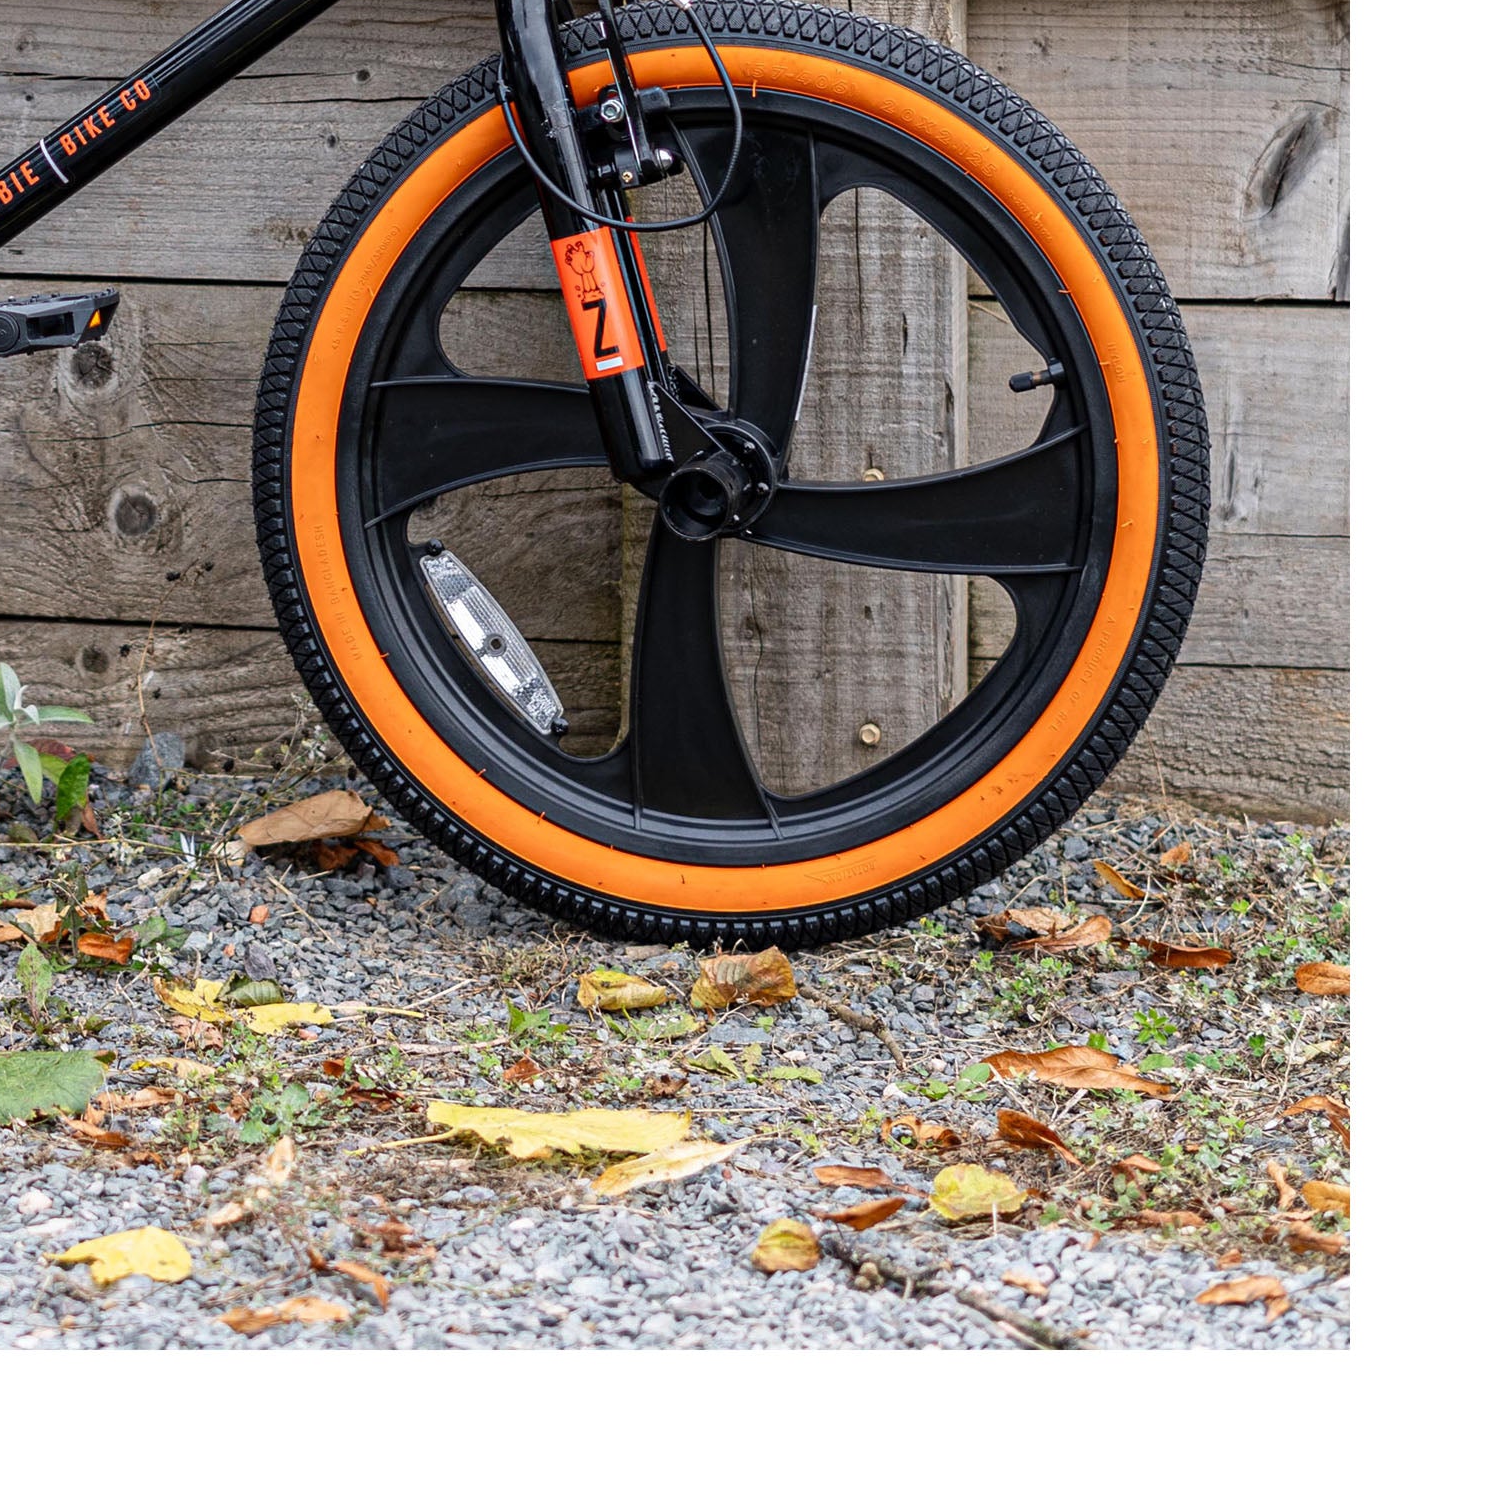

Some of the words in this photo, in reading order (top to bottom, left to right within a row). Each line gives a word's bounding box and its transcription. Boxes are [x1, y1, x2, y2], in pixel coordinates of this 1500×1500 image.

[59, 105, 116, 156] BIKE
[119, 78, 151, 112] CO
[581, 298, 620, 359] Z
